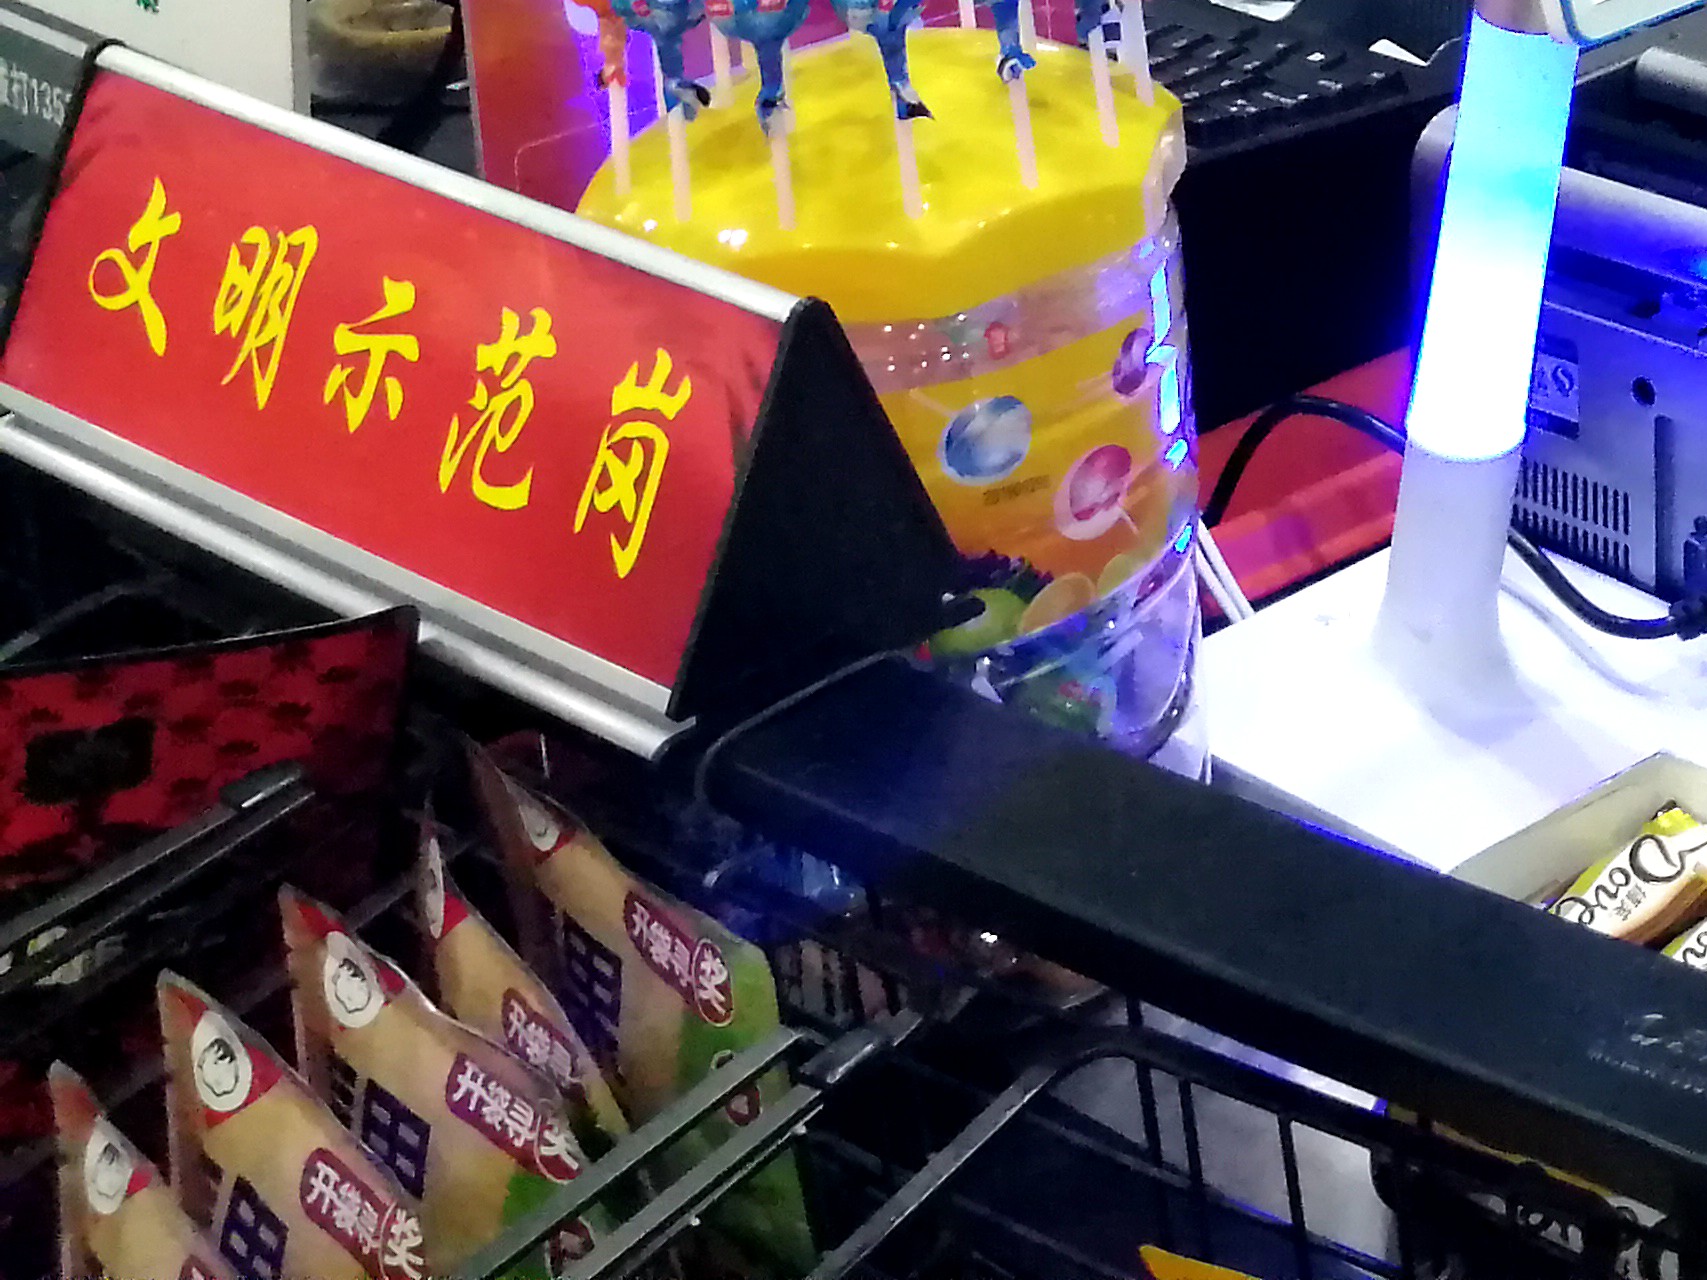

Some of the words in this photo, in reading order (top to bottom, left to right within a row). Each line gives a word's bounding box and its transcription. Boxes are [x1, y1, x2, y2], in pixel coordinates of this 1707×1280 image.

[88, 175, 693, 580] 文明示范岗
